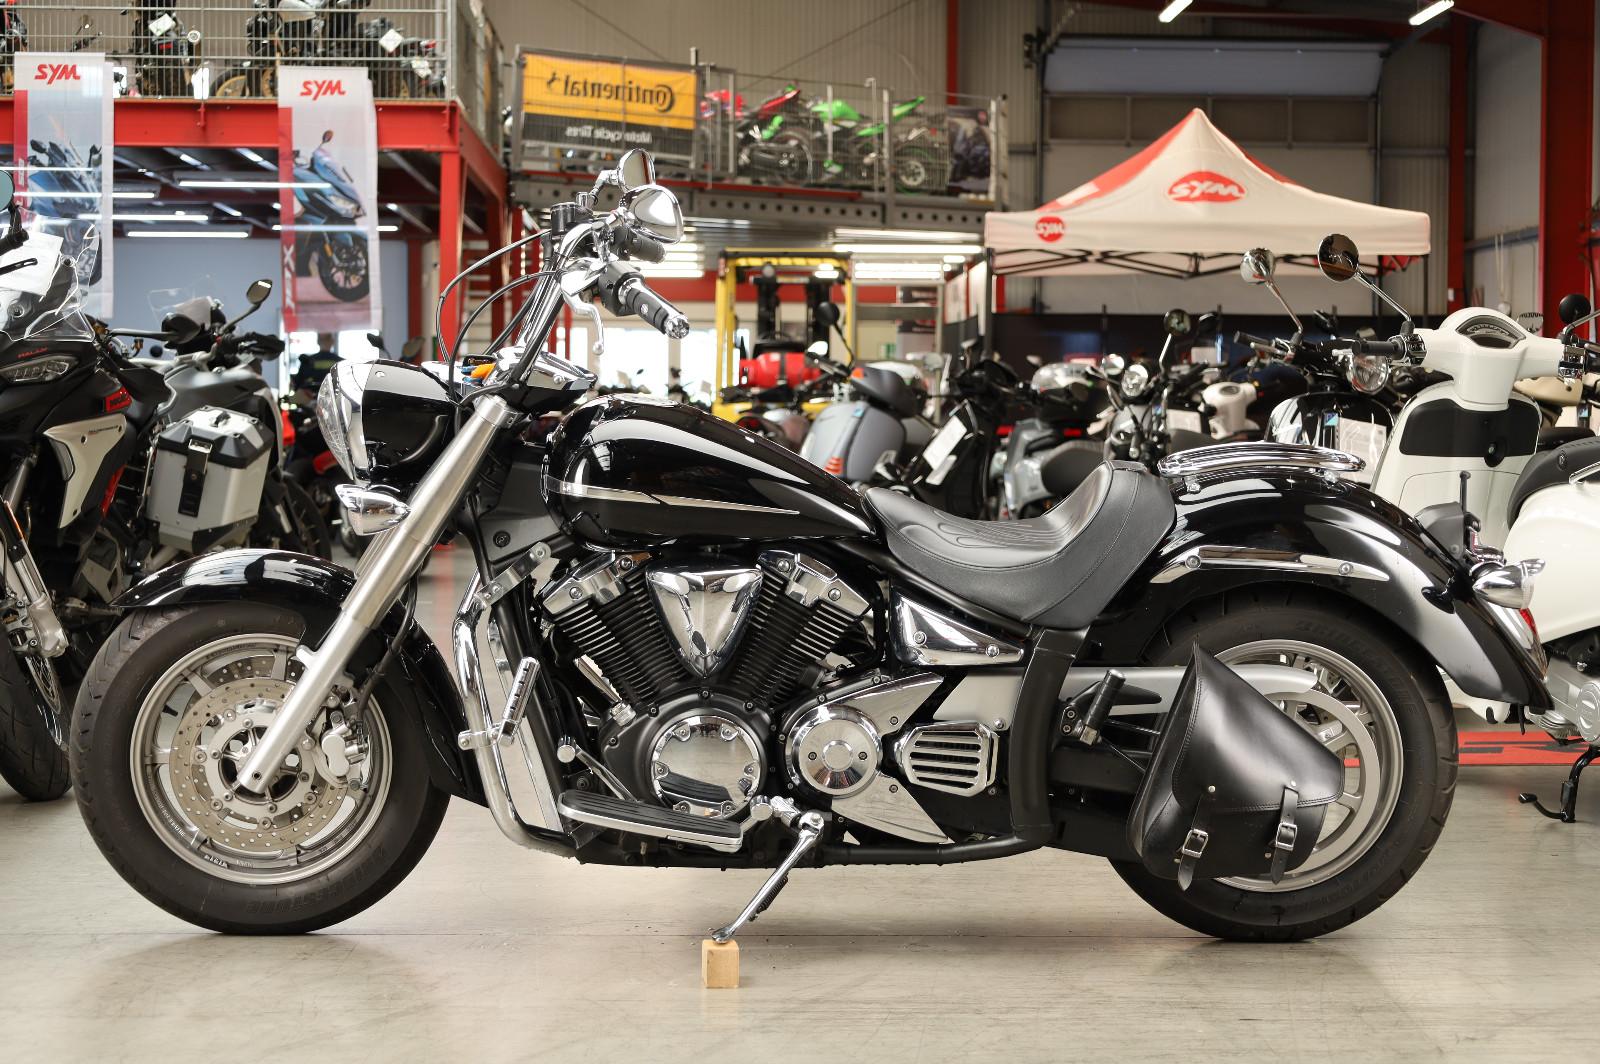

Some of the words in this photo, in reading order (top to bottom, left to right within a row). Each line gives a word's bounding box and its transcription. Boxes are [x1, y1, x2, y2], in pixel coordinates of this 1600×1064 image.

[34, 64, 81, 85] SYM
[300, 80, 346, 101] SYM
[1168, 180, 1245, 199] SYM
[1036, 222, 1064, 238] SYM
